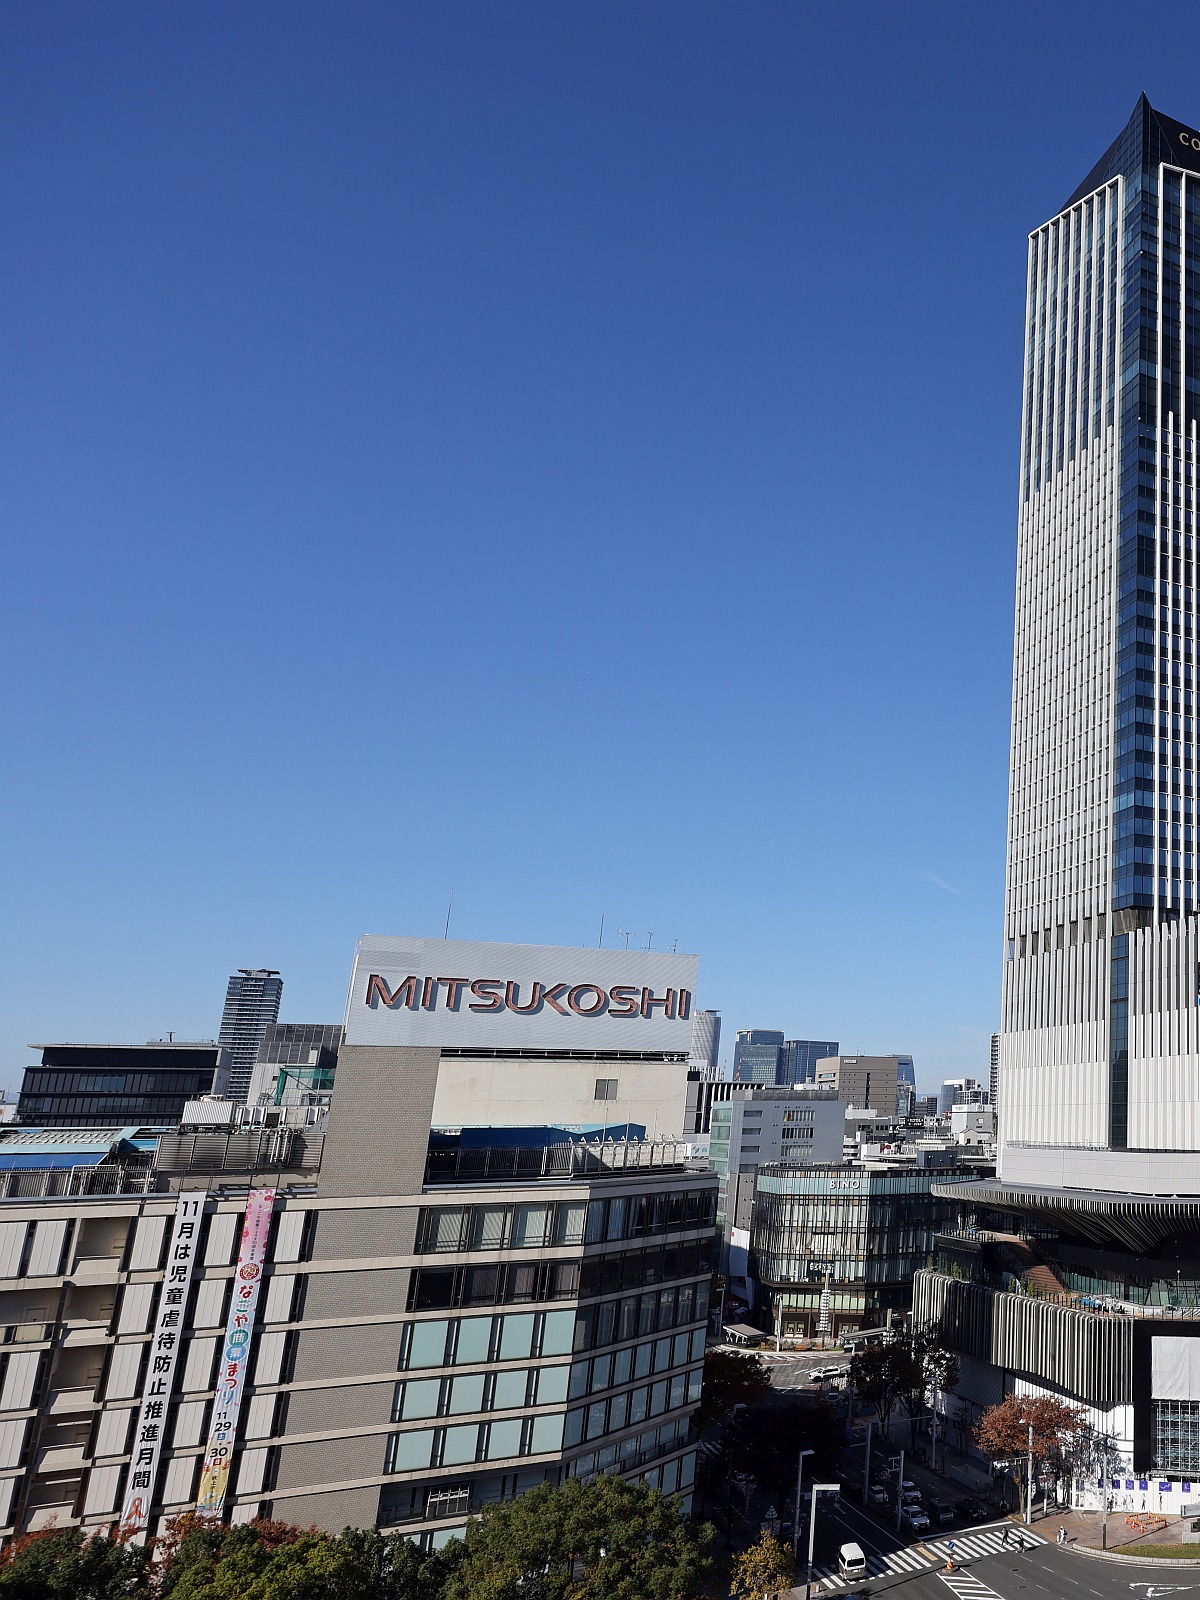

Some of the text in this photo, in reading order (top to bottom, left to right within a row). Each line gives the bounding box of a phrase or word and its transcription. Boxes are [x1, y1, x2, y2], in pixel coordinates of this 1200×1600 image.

[365, 974, 688, 1017] MITSUKOSHI
[829, 1179, 860, 1189] BINO
[131, 1200, 199, 1490] 11月は児童虐待防止推進月間
[222, 1284, 254, 1406] なごや商業まつり
[216, 1411, 227, 1420] 11
[214, 1421, 232, 1432] 29
[209, 1446, 228, 1458] 30
